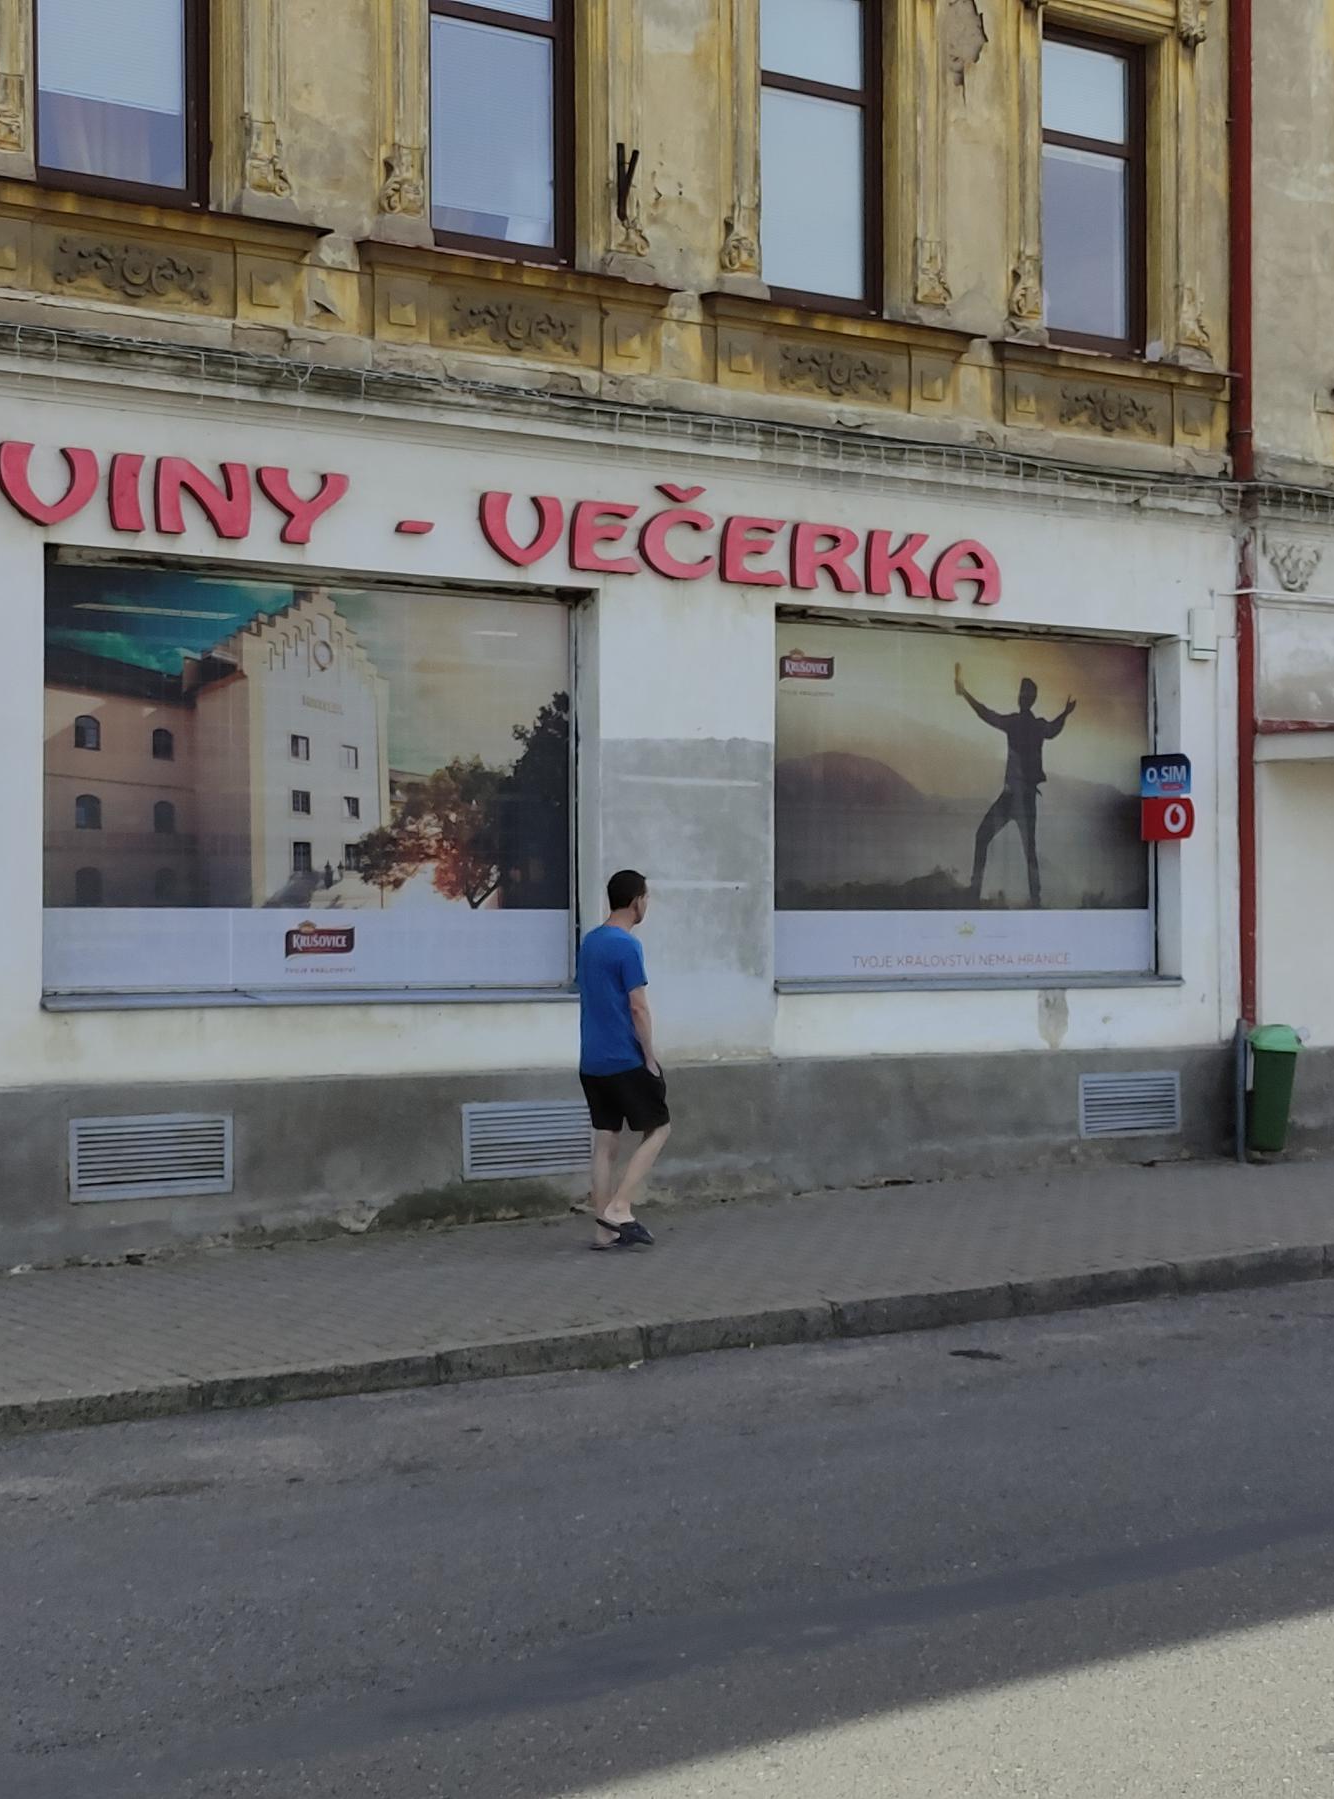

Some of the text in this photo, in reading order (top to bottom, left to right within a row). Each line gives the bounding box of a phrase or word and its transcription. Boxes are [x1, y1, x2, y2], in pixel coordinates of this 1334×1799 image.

[479, 483, 1002, 606] VEČERKA
[1161, 765, 1186, 782] SIM
[852, 954, 893, 969] TVOJE
